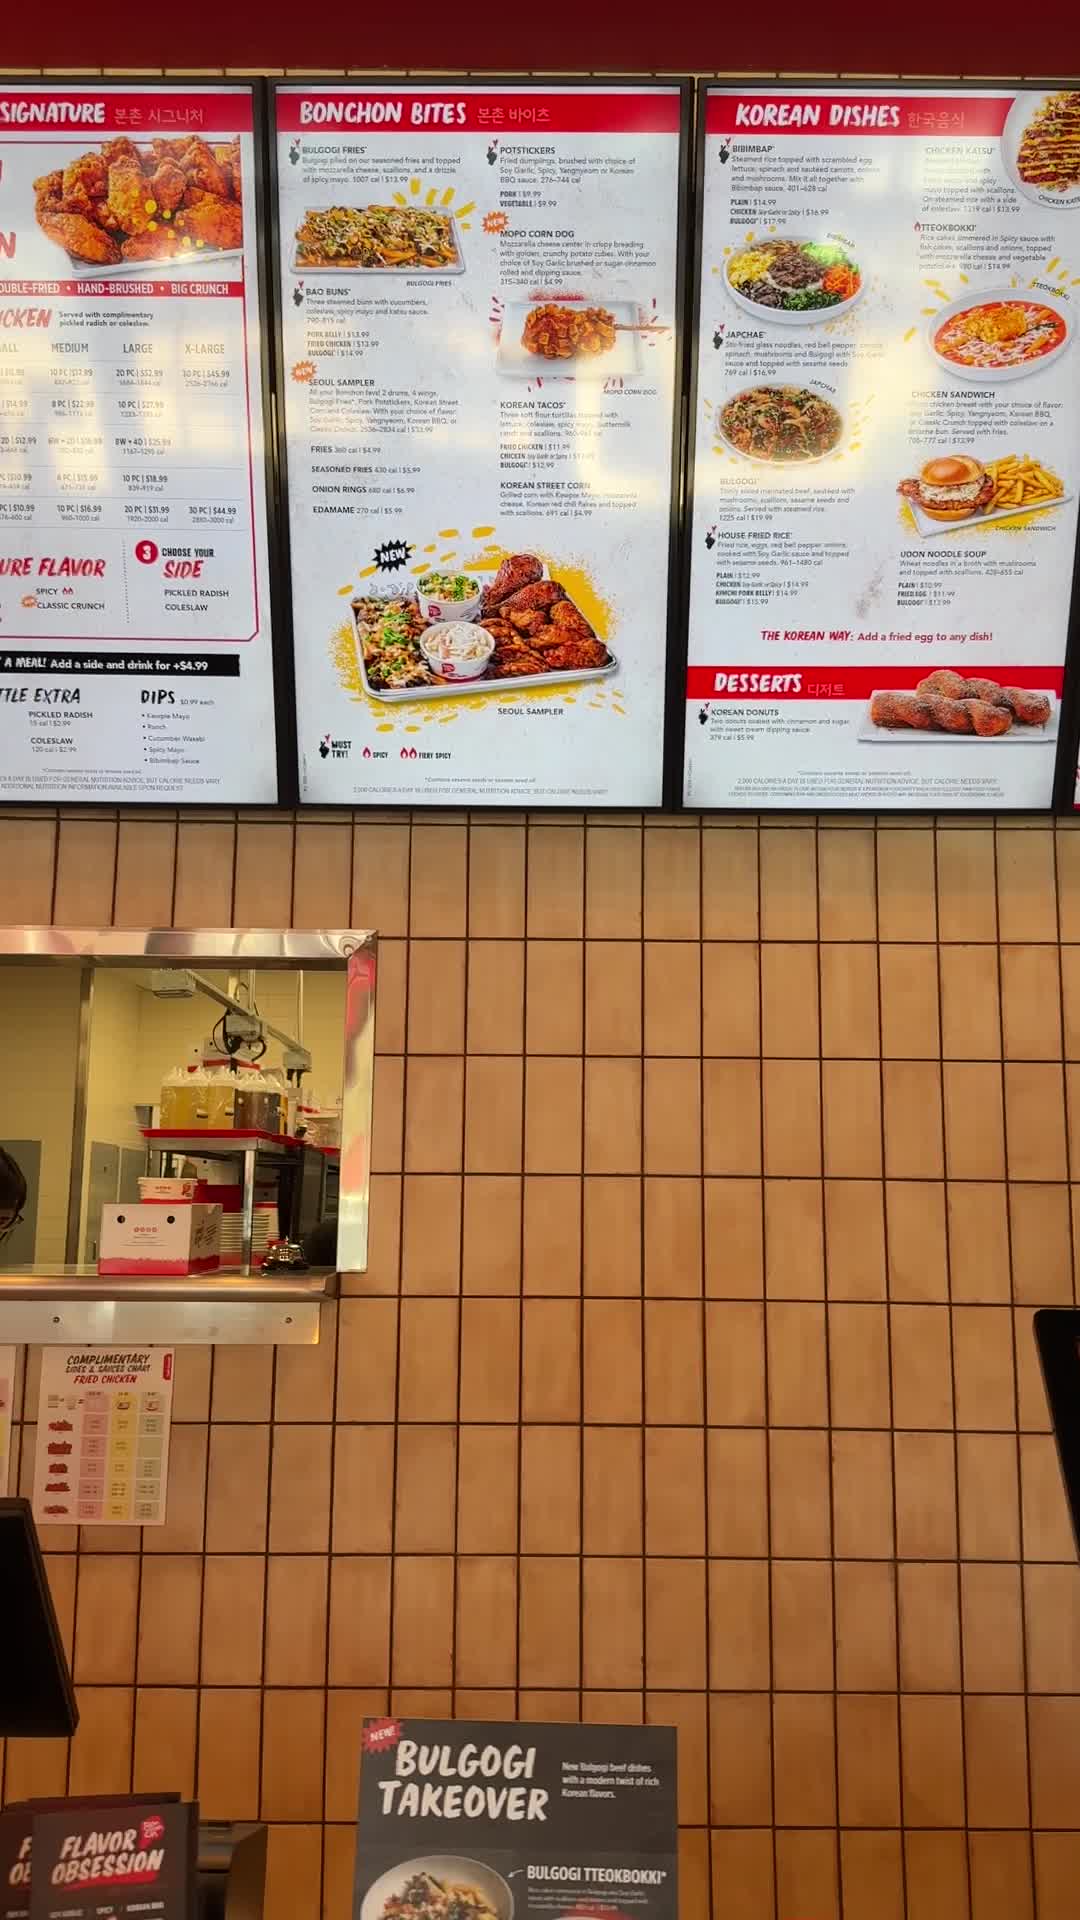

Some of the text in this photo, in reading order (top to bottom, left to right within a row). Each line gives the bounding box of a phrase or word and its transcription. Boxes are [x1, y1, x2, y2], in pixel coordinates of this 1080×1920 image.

[0, 101, 105, 123] SIGNATURE
[114, 108, 204, 125] 본촌 시그니처
[300, 102, 466, 124] BONCHON BITES
[477, 108, 551, 123] 본촌 바이츠
[736, 103, 900, 128] KOREAN DISHES
[908, 111, 965, 128] 한국음식
[77, 282, 154, 295] HAND-BRUSHED
[171, 283, 187, 295] BIG
[189, 283, 229, 295] CRUNCH
[103, 312, 154, 321] complimentary
[52, 343, 226, 355] MEDIUM LARGE X-LARGE
[142, 546, 152, 560] 3
[162, 548, 214, 557] CHOOSE YOUR
[379, 547, 406, 563] NEW
[38, 557, 106, 577] FLAVOR
[163, 560, 204, 578] SIDE
[761, 631, 781, 640] THE
[784, 631, 826, 641] KOREAN
[829, 631, 854, 642] WAY:
[857, 633, 878, 642] Add
[889, 632, 912, 642] fried
[914, 634, 932, 643] egg
[936, 633, 947, 642] to
[949, 634, 967, 644] any
[970, 632, 993, 642] dish!
[5, 658, 12, 667] A
[16, 658, 46, 668] MEAL!
[50, 660, 72, 668] Add
[83, 660, 103, 669] side
[106, 660, 124, 669] and
[127, 660, 153, 670] drink
[155, 661, 170, 670] for
[173, 662, 208, 671] +$4.99
[714, 673, 802, 693] DESSERTS
[807, 683, 845, 697] 디저트
[34, 688, 80, 704] EXTRA
[140, 690, 175, 704] DIPS
[498, 707, 564, 716] SEOUL SAMPLER
[711, 709, 780, 717] KOREAN DONUTS
[331, 741, 351, 750] MUST
[332, 750, 348, 759] TRY!
[373, 751, 388, 759] SPICY
[418, 751, 452, 760] FIERY SPICY
[67, 1354, 151, 1364] COMPLIMENTARY
[74, 1374, 138, 1384] FRIED CHICKEN
[369, 1725, 396, 1742] NEW!
[396, 1740, 537, 1779] BULGOGI
[561, 1762, 652, 1774] New Bulgogi beef dishes
[561, 1774, 578, 1784] with
[586, 1775, 615, 1785] modern
[616, 1776, 634, 1786] twist
[635, 1776, 644, 1786] of
[645, 1777, 659, 1786] rich
[378, 1780, 549, 1821] TAKEOVER
[561, 1788, 616, 1799] Korean flavors.
[60, 1829, 137, 1860] FLAVOR
[51, 1849, 164, 1884] OBSESSION
[527, 1866, 581, 1881] BULGOGI
